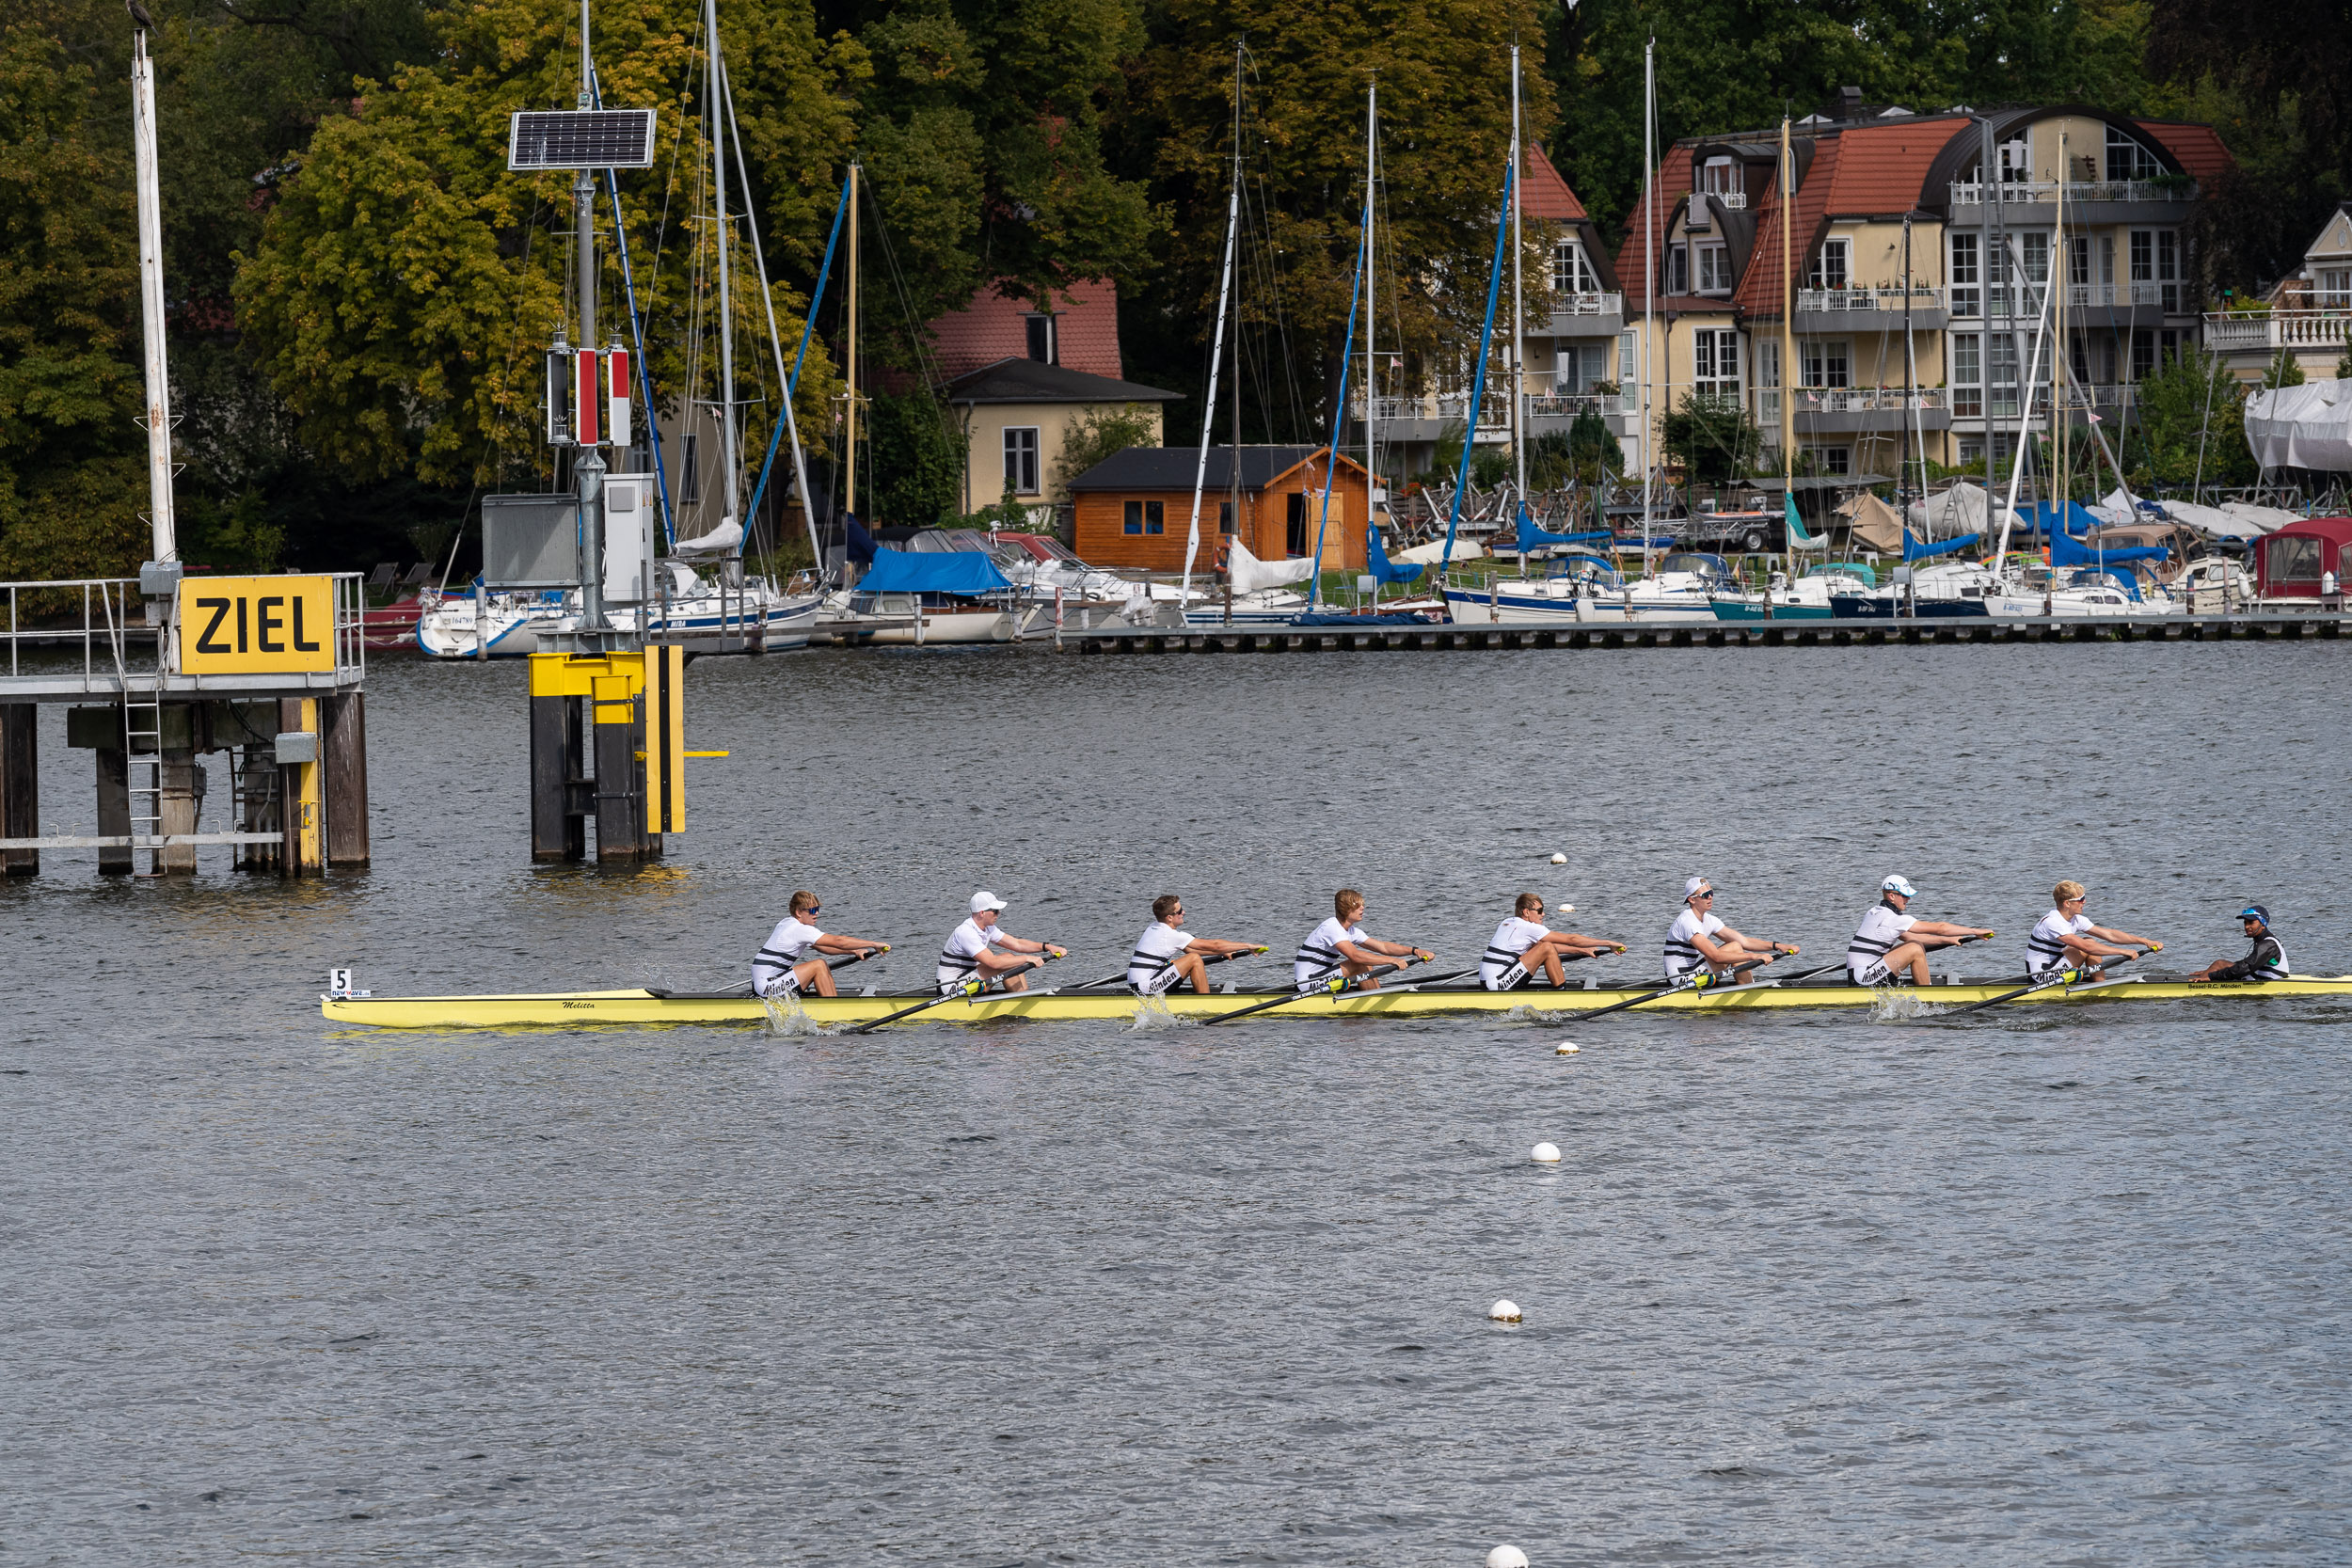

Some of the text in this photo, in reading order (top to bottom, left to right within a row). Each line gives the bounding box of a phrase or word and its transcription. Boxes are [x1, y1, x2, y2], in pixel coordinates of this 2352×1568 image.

[196, 595, 320, 654] ZIEL
[670, 620, 686, 628] MIRA
[337, 970, 346, 990] 5
[1497, 968, 1524, 990] Minden
[1862, 965, 1887, 983] Minden
[562, 1001, 596, 1009] Melitta
